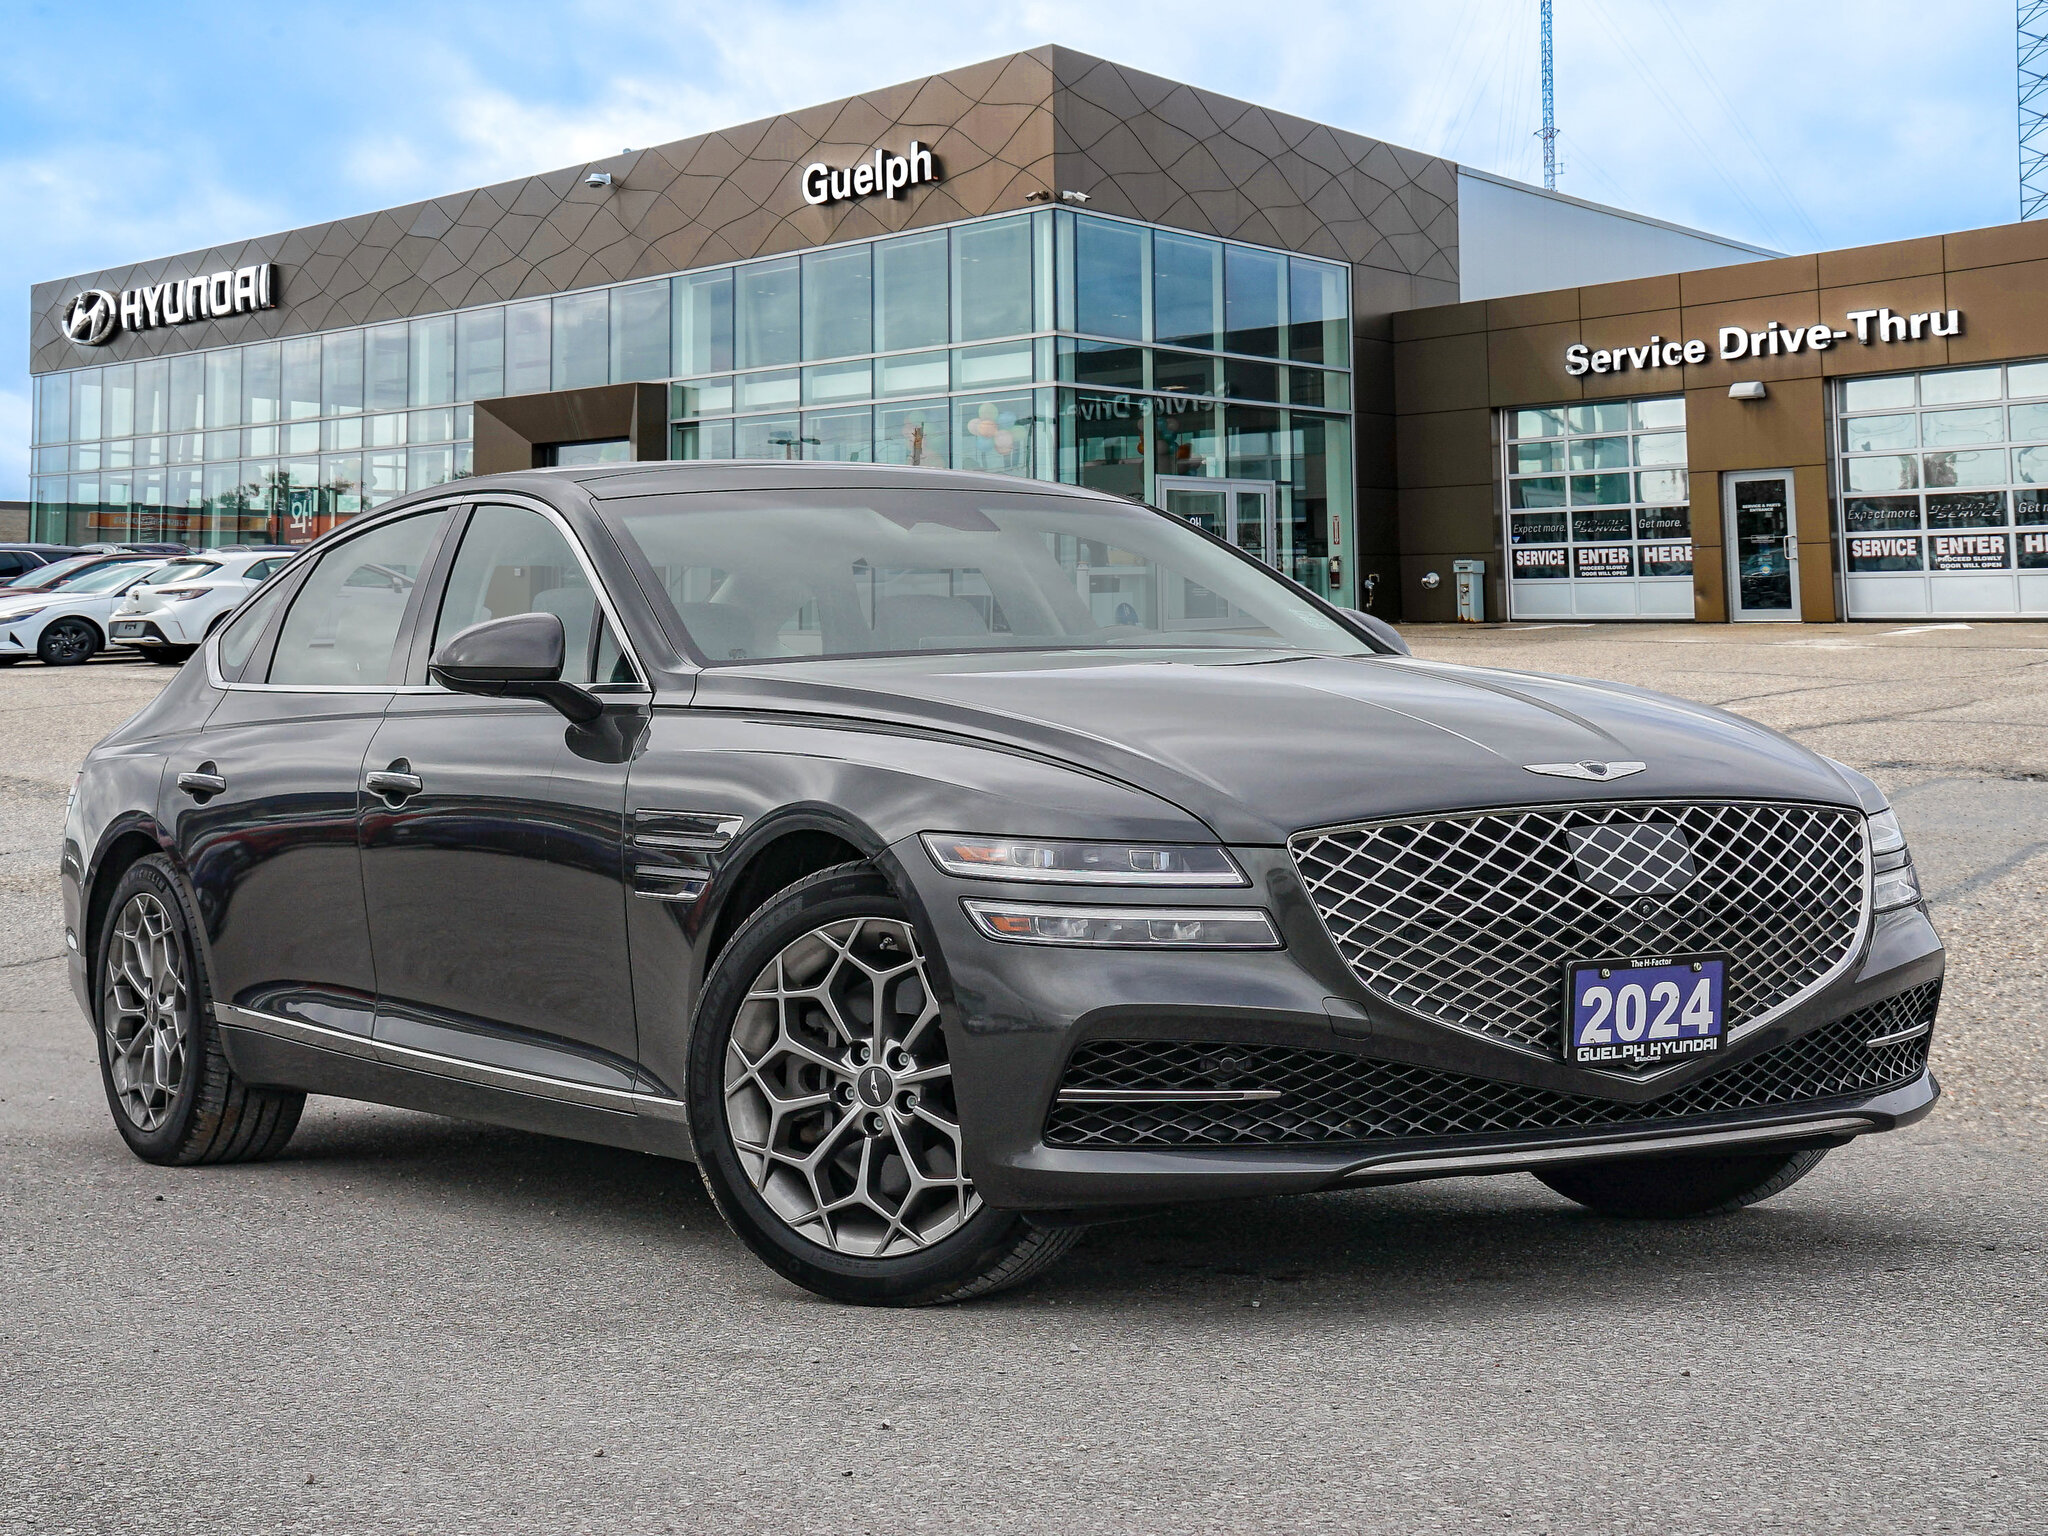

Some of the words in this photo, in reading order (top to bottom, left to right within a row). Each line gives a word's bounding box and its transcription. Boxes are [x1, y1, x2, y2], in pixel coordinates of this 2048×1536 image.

[801, 140, 934, 205] Guelph
[120, 263, 273, 331] HYUNDAI
[1564, 335, 1706, 377] Service
[1718, 307, 1961, 361] Drive-Thru
[1847, 509, 1885, 521] Expect
[1887, 509, 1919, 519] more.
[1935, 508, 2002, 519] SERVICE
[2018, 502, 2040, 514] Get
[1512, 523, 1541, 535] Expect
[1542, 523, 1567, 533] more.
[1578, 524, 1630, 533] SERVICE
[1638, 519, 1657, 529] Get
[1658, 518, 1683, 528] more.
[1852, 538, 1917, 558] SERVICE
[1935, 535, 2006, 556] ENTER
[1516, 550, 1565, 566] SERVICE
[1578, 548, 1630, 565] ENTER
[1644, 545, 1693, 563] HERE
[1631, 959, 1643, 968] The
[1644, 958, 1672, 967] H-Factor
[1579, 978, 1714, 1045] 2024
[1577, 1043, 1646, 1062] GUELPH
[1649, 1037, 1718, 1056] HYUNDAI
